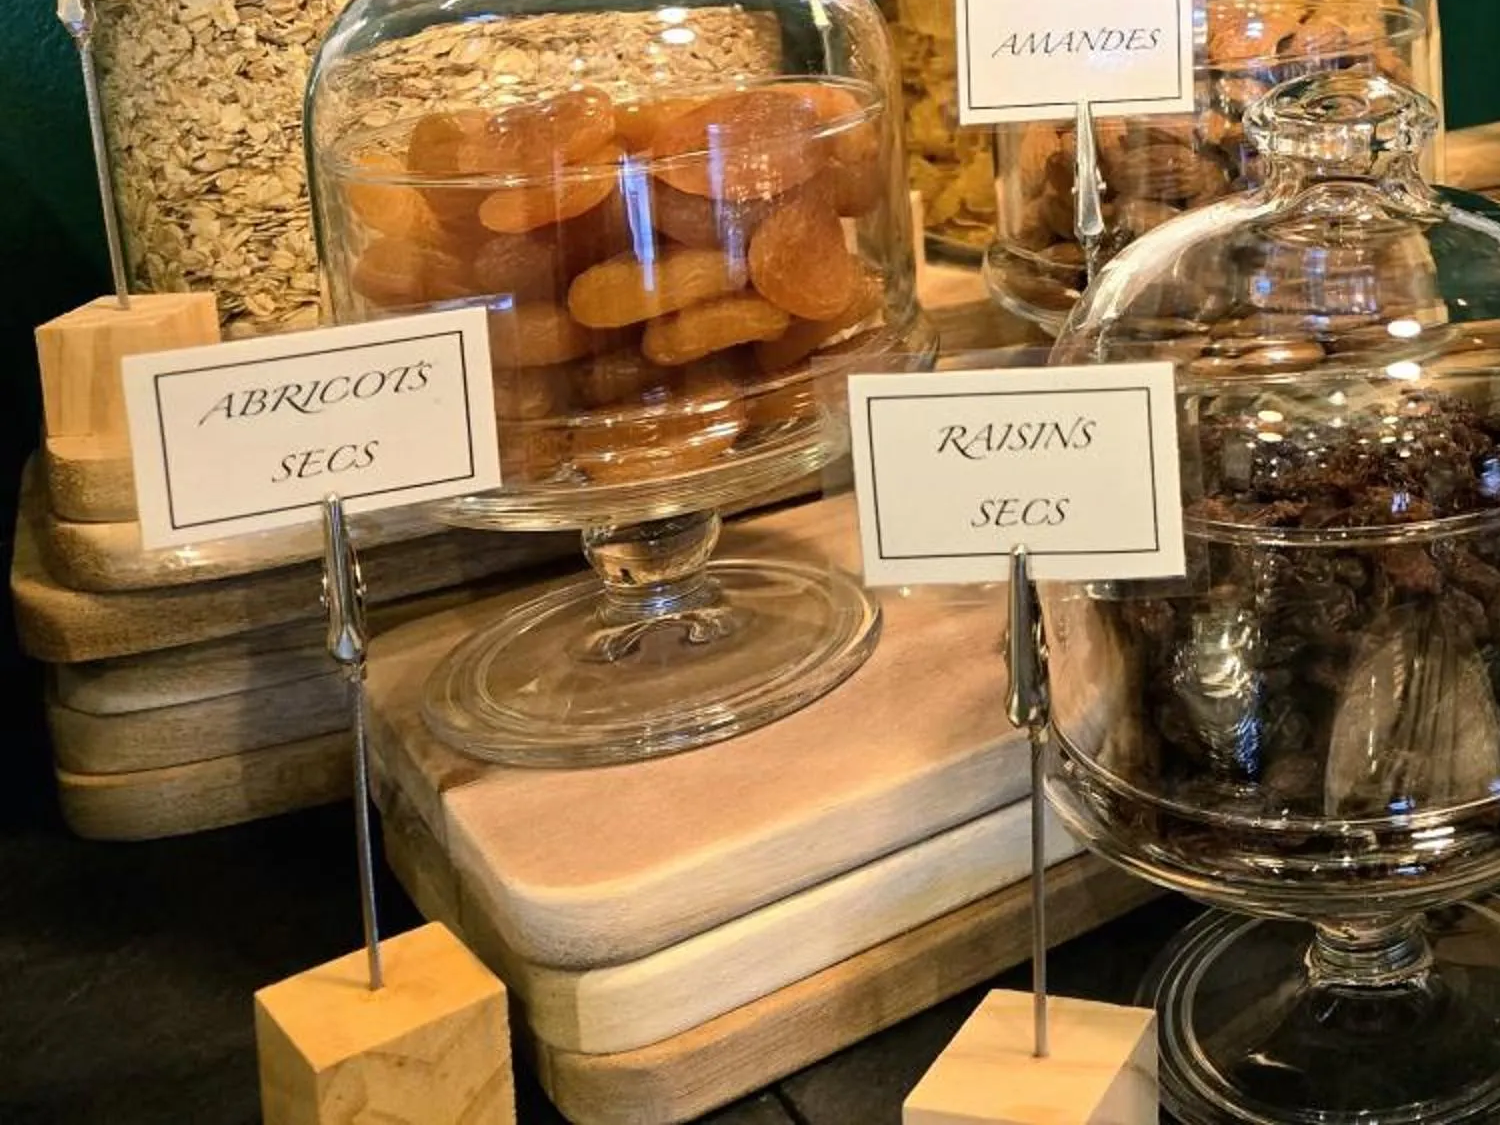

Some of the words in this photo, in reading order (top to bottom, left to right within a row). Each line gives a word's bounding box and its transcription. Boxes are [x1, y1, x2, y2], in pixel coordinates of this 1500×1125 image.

[991, 27, 1161, 59] AMANDES
[198, 359, 433, 428] ABRICOTS
[936, 416, 1096, 461] RAISINS
[271, 439, 379, 483] SECS
[971, 498, 1070, 528] SECS
